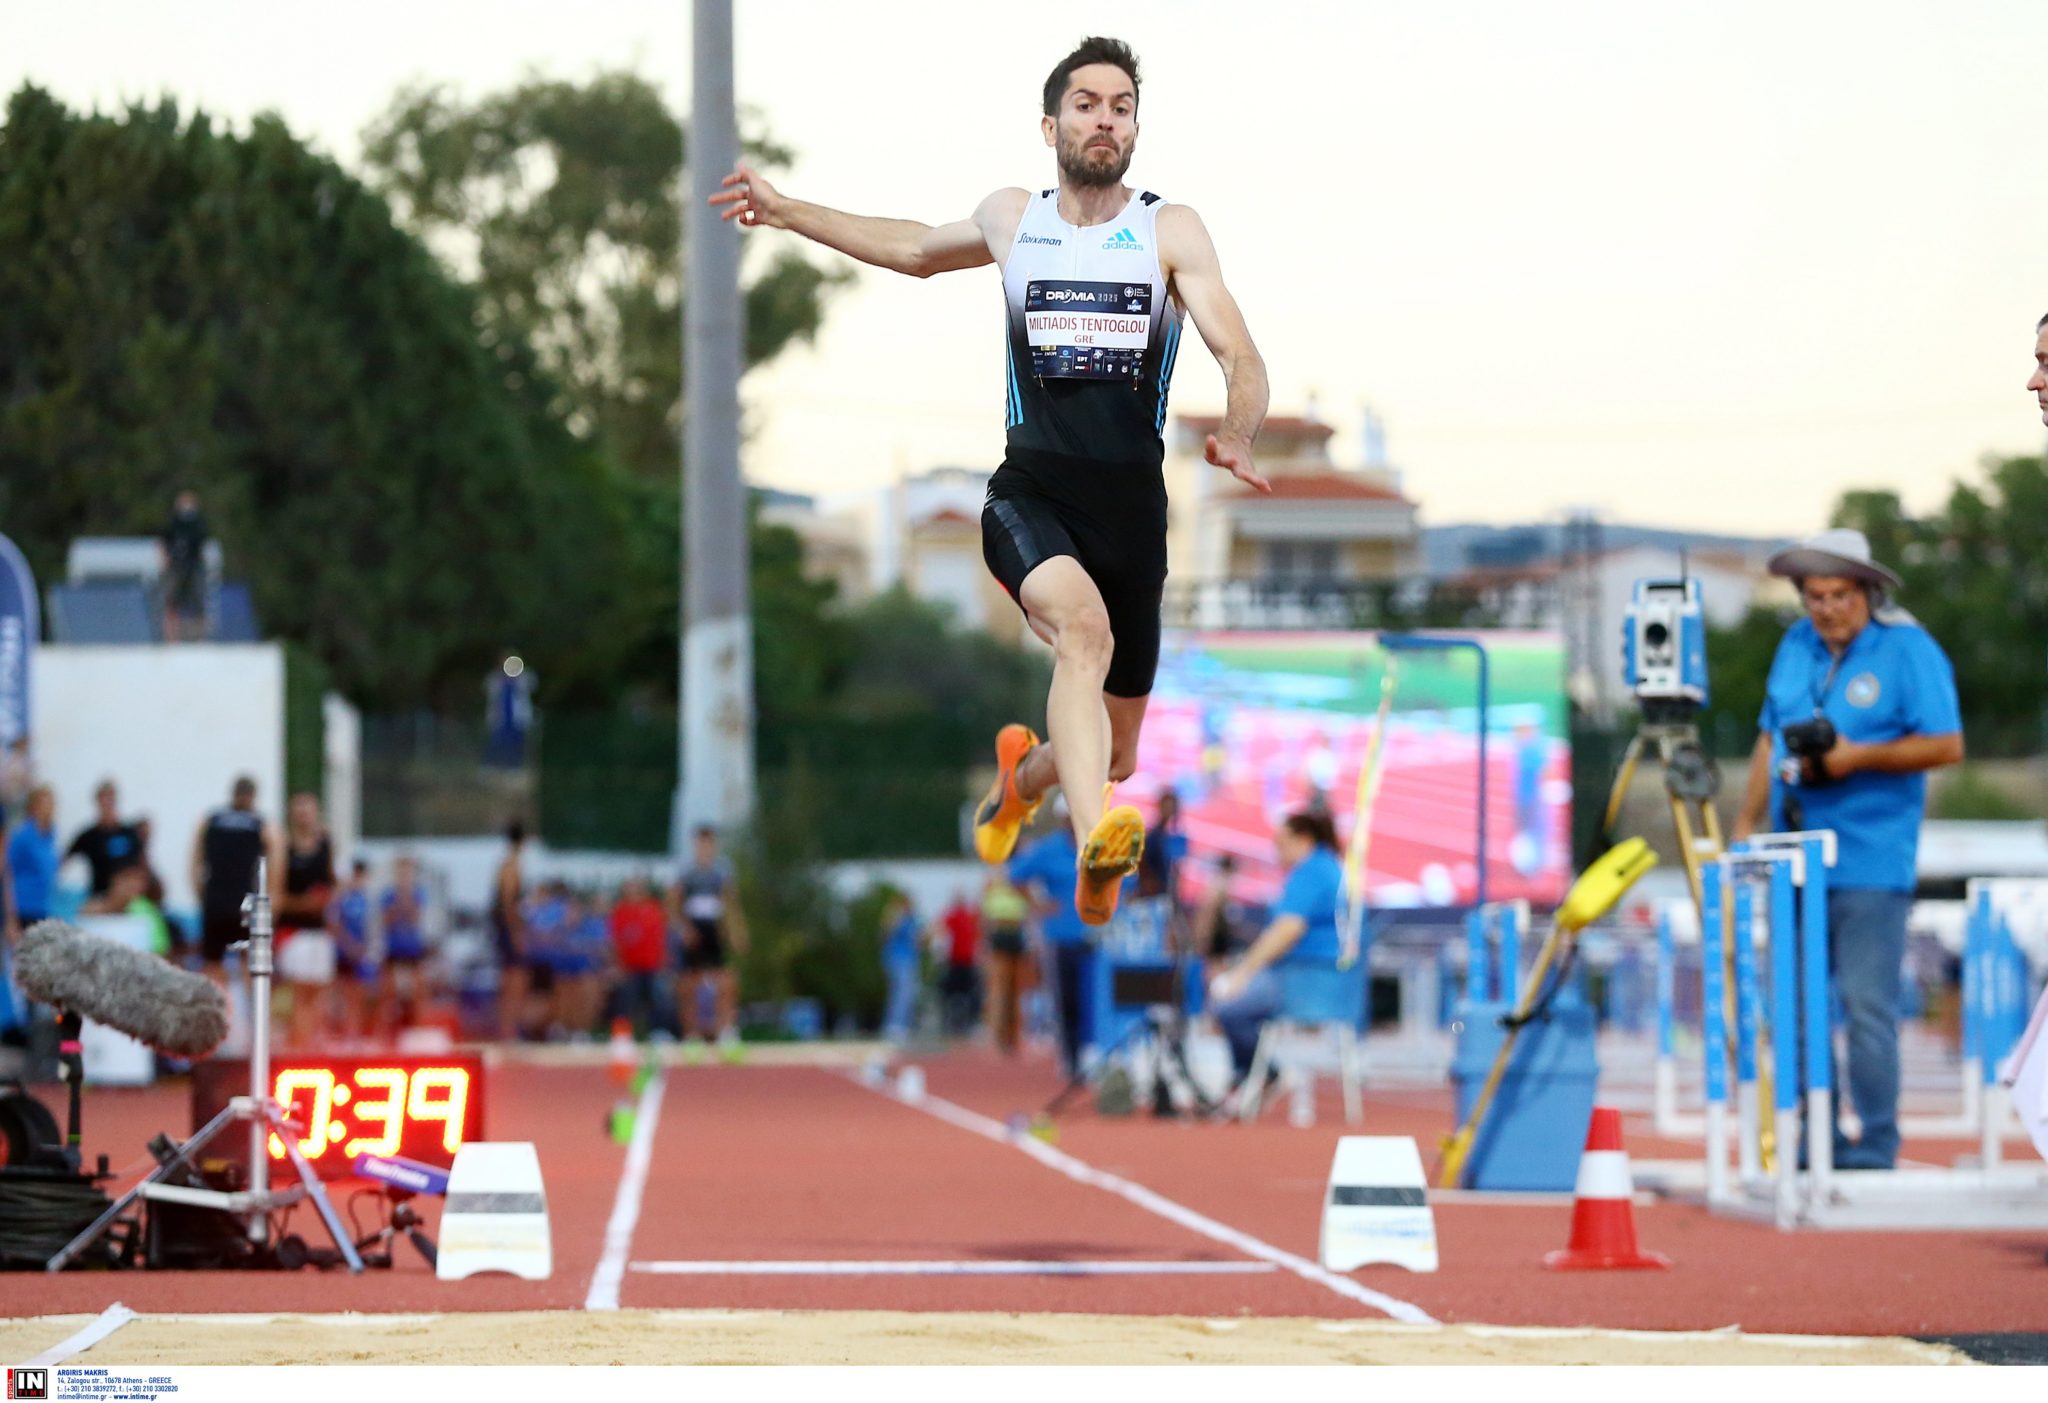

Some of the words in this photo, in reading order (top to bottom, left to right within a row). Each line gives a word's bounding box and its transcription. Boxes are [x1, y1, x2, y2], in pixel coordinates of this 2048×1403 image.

[1018, 232, 1062, 246] Stoiximan
[1102, 240, 1144, 251] adidas
[1028, 316, 1078, 330] MILTIADIS
[1080, 317, 1146, 333] TENTOGLOU
[1074, 334, 1095, 344] GRE
[267, 1067, 470, 1160] 0:39
